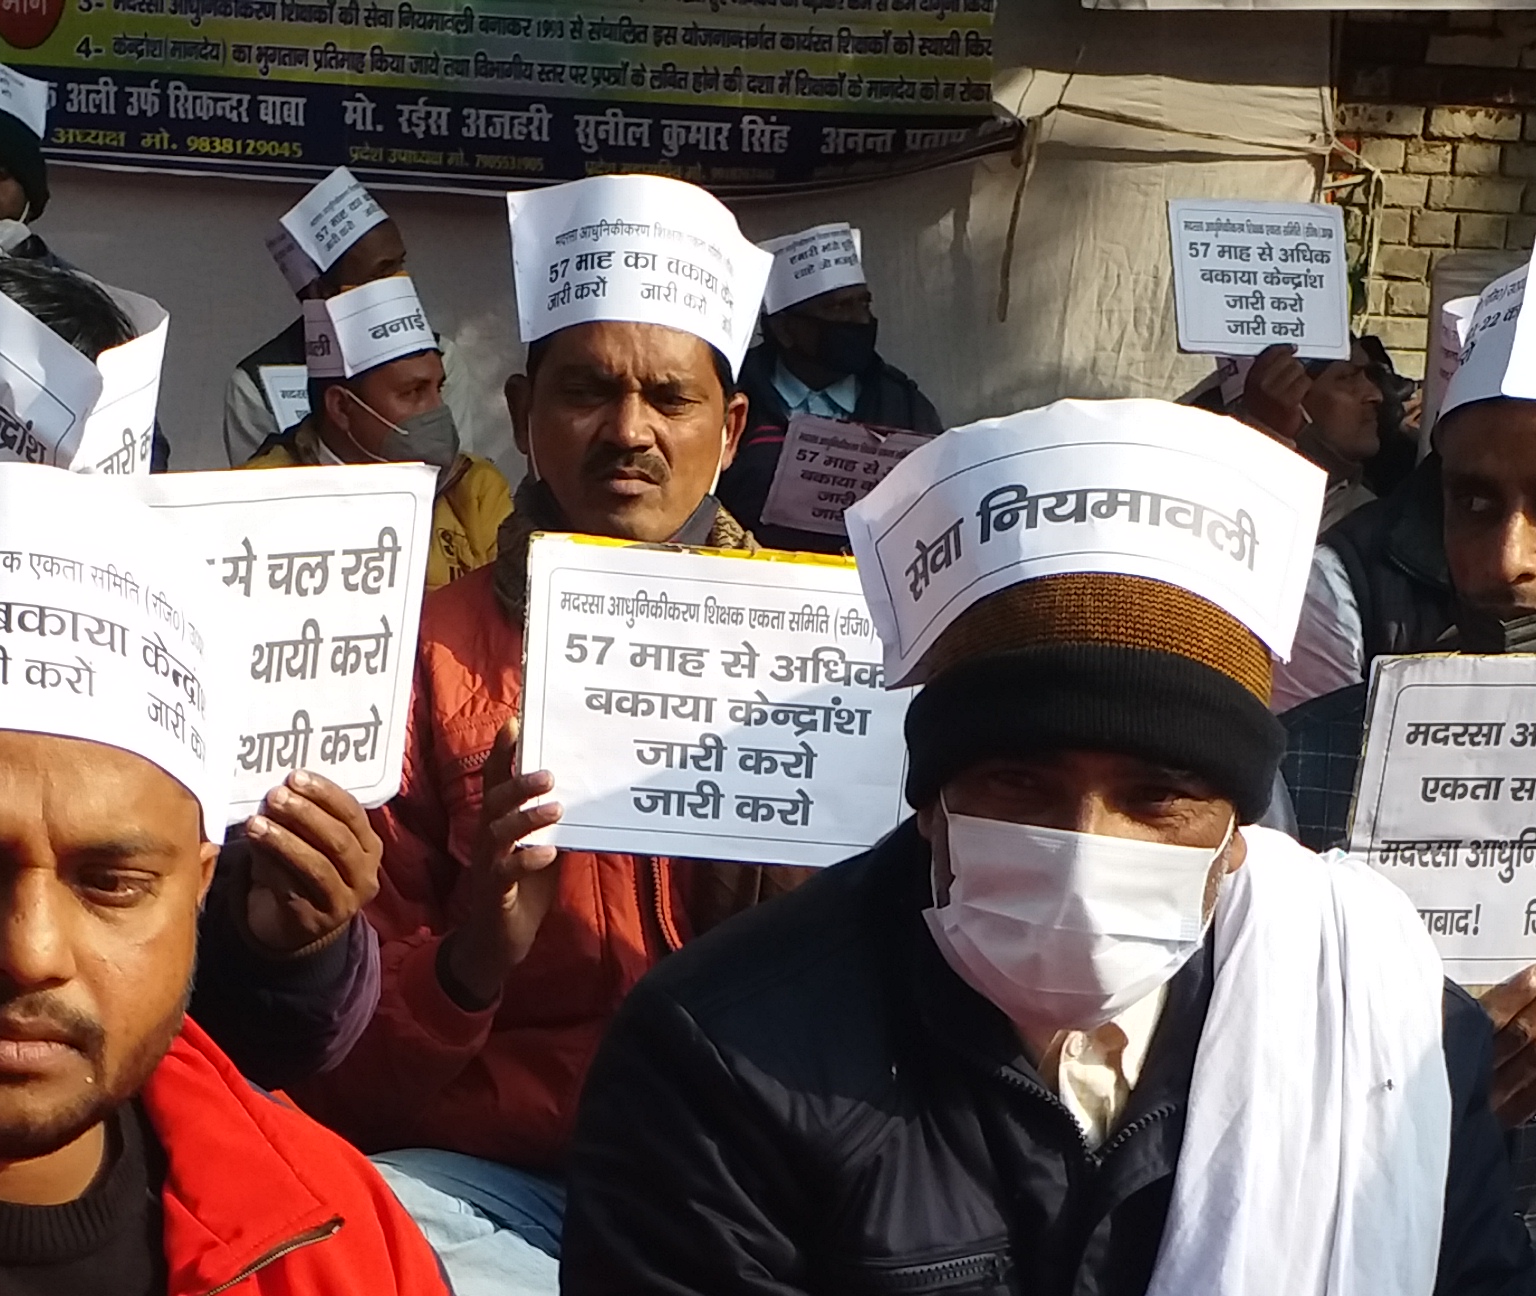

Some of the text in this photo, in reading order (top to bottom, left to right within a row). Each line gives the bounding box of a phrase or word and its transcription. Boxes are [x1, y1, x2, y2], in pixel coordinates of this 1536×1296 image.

[65, 77, 307, 126] अली उर्फ सिकन्दर बाबा
[341, 92, 553, 142] मो. रईस अजहरी
[186, 136, 302, 158] 9838129045
[574, 108, 791, 157] सुनील कुमार सिंह
[821, 127, 896, 155] अनन्त
[549, 251, 658, 283] 57 माह का
[1188, 241, 1331, 265] 57 माह से अधिक
[640, 281, 678, 304] जारी
[1263, 266, 1324, 290] केन्द्रांश
[1224, 290, 1304, 313] जारी करो
[368, 308, 426, 340] बनाई
[1225, 315, 1305, 338] जारी करो
[268, 526, 402, 597] चल रही
[904, 484, 1259, 602] सेवा नियमावली
[29, 552, 84, 583] एकता
[91, 563, 140, 605] समिति
[561, 590, 829, 634] मदरसा आधुनिकीकरण शिक्षक एकता समिति
[330, 615, 393, 676] करो
[565, 633, 885, 688] 57 माह से अधिक
[25, 656, 96, 699] करों
[585, 687, 872, 737] बकाया केन्द्रांश
[320, 704, 382, 765] करो
[633, 733, 817, 779] जारी करो
[1406, 721, 1505, 748] मदरसा
[630, 780, 814, 826] जारी करो
[1421, 776, 1505, 803] एकता
[1379, 838, 1464, 869] मदरसा
